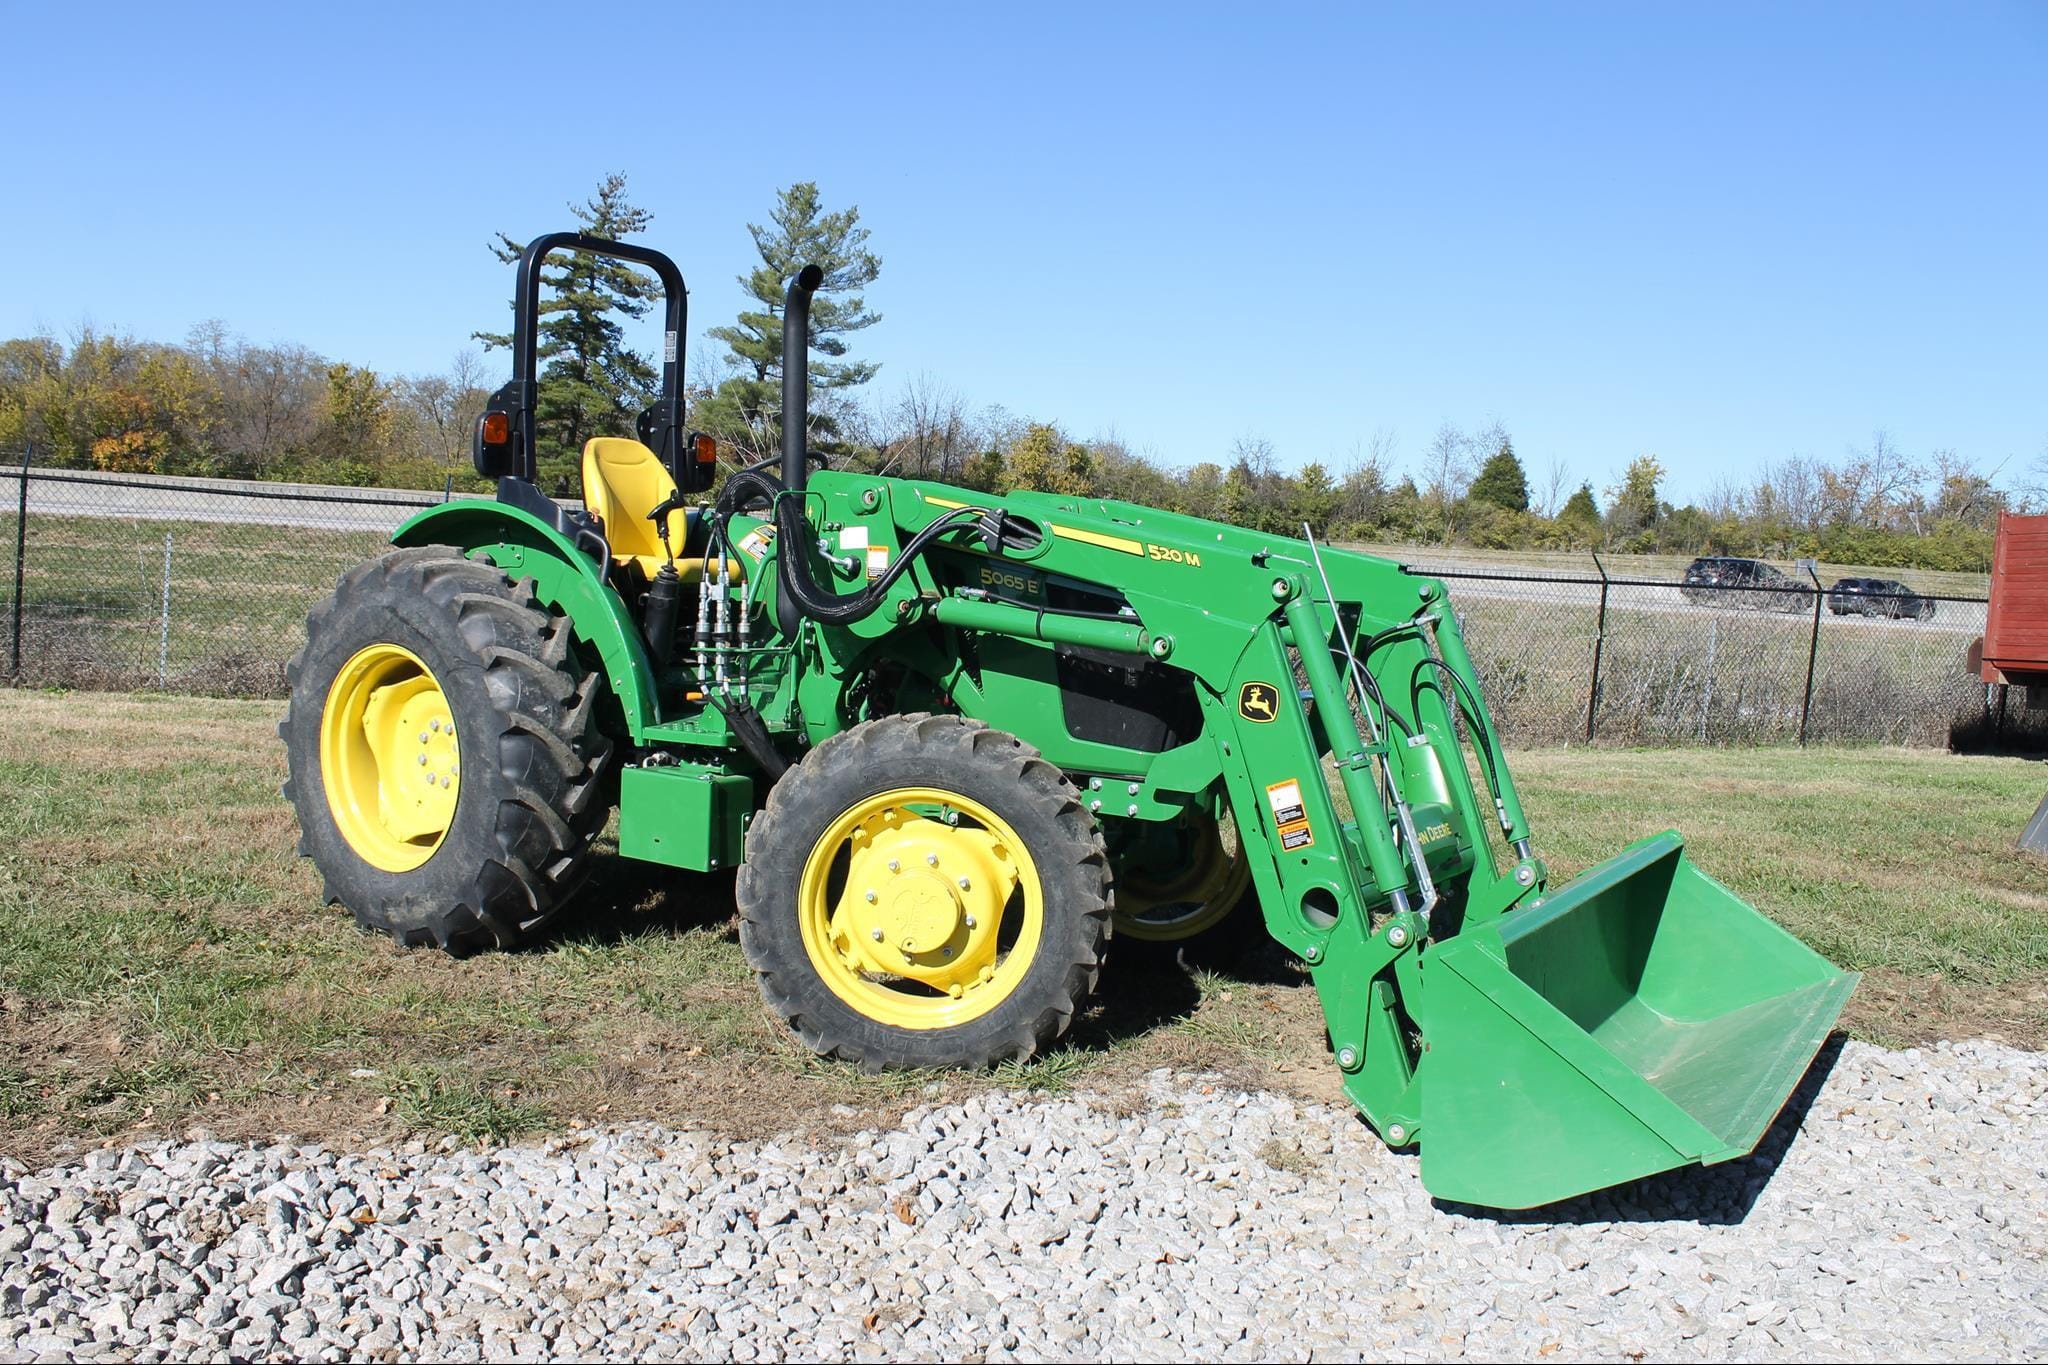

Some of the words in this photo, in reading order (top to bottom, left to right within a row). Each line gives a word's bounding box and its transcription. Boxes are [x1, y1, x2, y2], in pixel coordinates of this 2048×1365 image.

[1147, 543, 1183, 563] 520
[1184, 551, 1201, 568] M
[980, 568, 1025, 591] 5065
[1027, 579, 1039, 594] E
